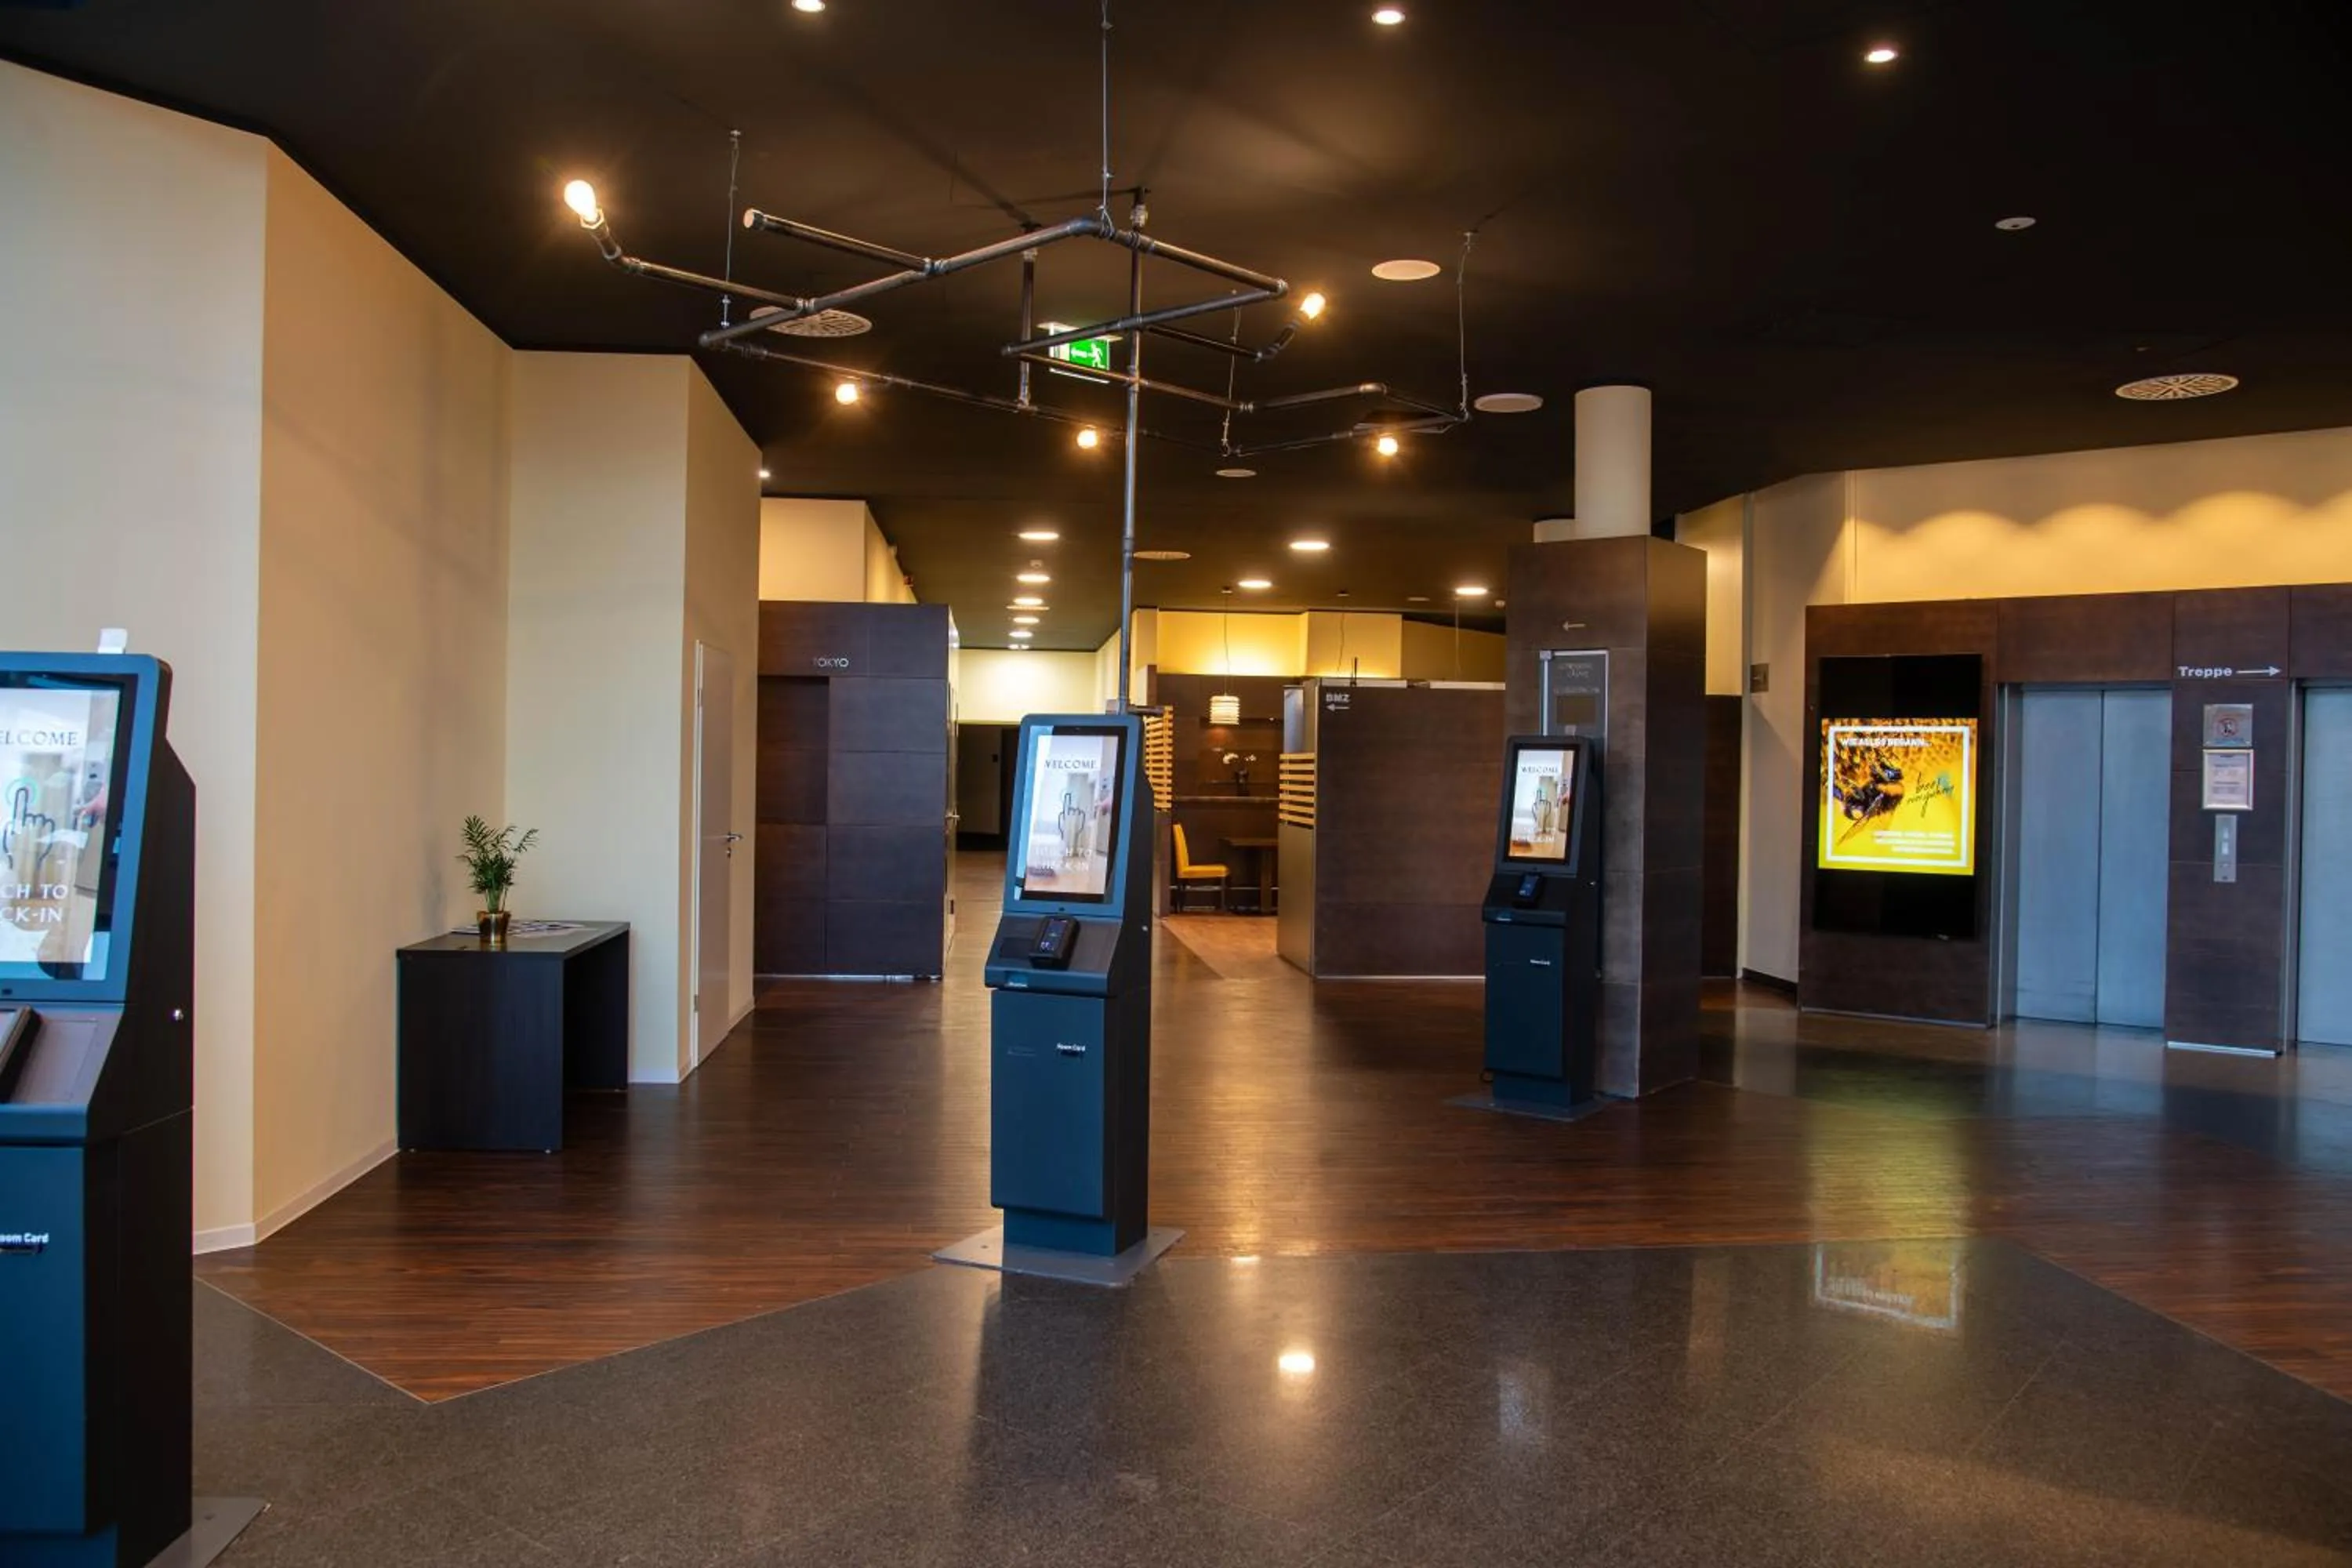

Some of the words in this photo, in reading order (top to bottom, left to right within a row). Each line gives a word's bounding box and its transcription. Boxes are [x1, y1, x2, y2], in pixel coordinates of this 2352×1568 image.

[2176, 666, 2233, 678] Treppe
[0, 730, 78, 746] LCOME
[40, 884, 68, 900] TO
[0, 906, 63, 923] CK-IN
[0, 1234, 22, 1243] oom
[24, 1232, 49, 1244] Card
